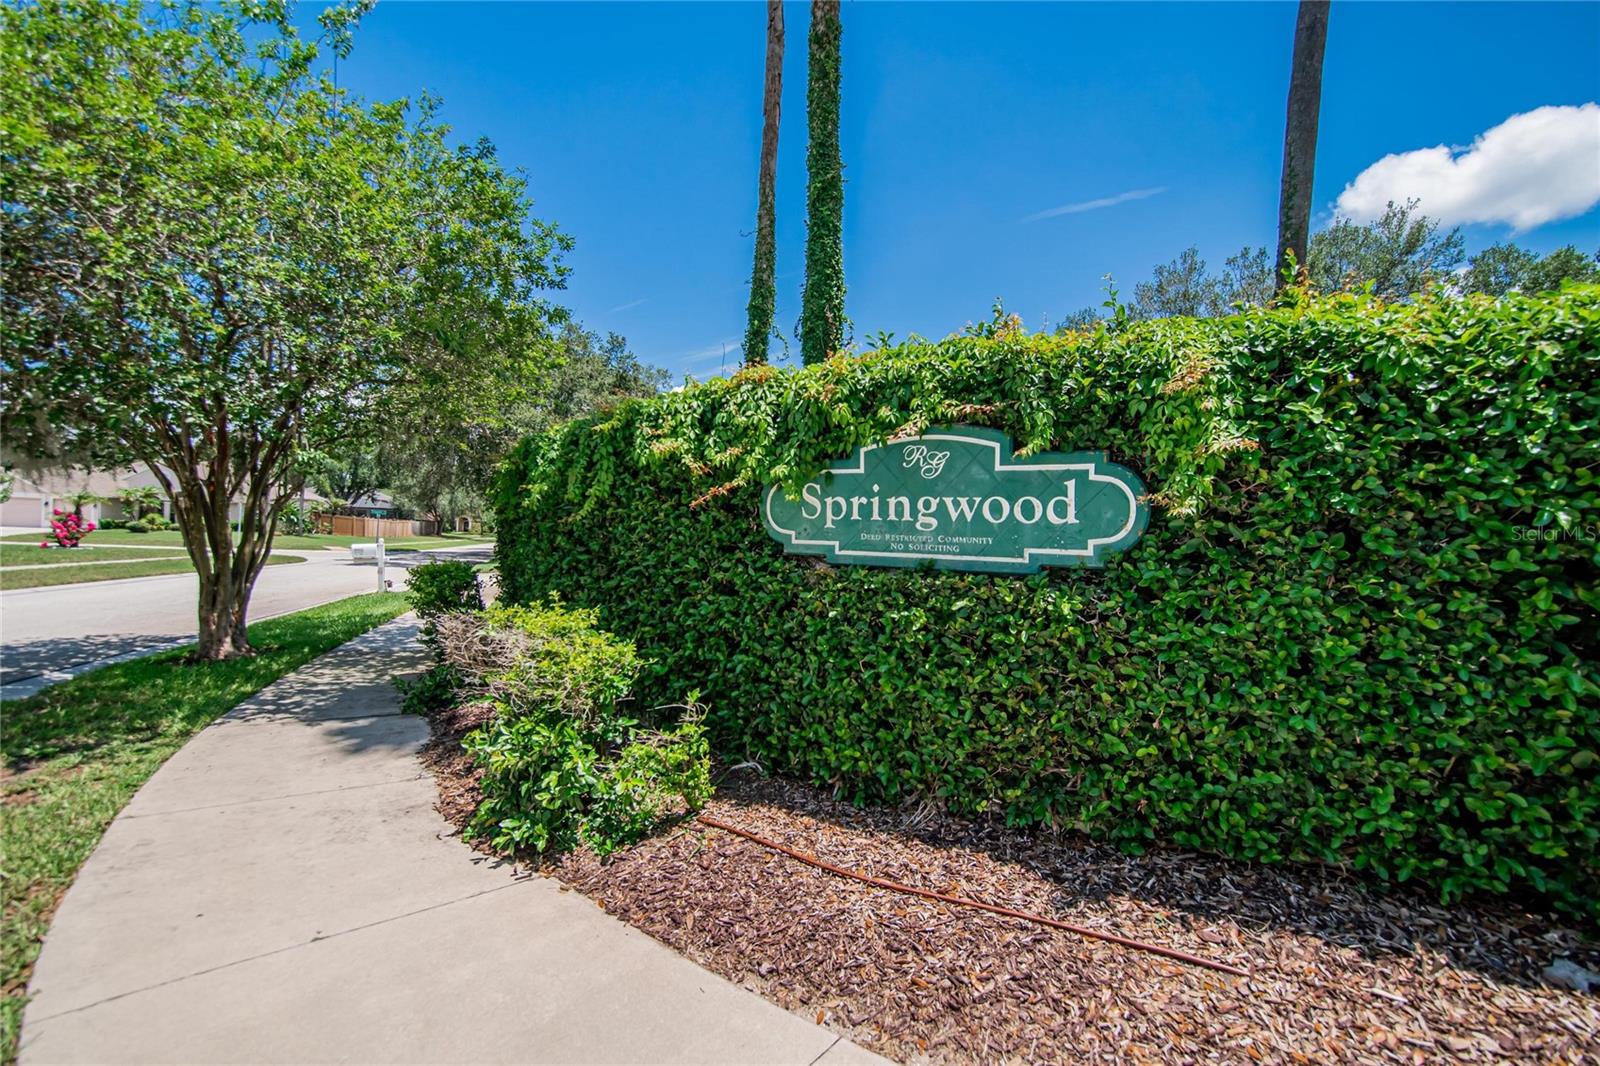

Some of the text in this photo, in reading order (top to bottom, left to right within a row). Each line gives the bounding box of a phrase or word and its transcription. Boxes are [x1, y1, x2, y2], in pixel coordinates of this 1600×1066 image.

[902, 444, 950, 479] RG
[801, 479, 1079, 531] Springwood
[890, 542, 960, 553] NO SOLICITING
[937, 535, 993, 545] COMMUNITY
